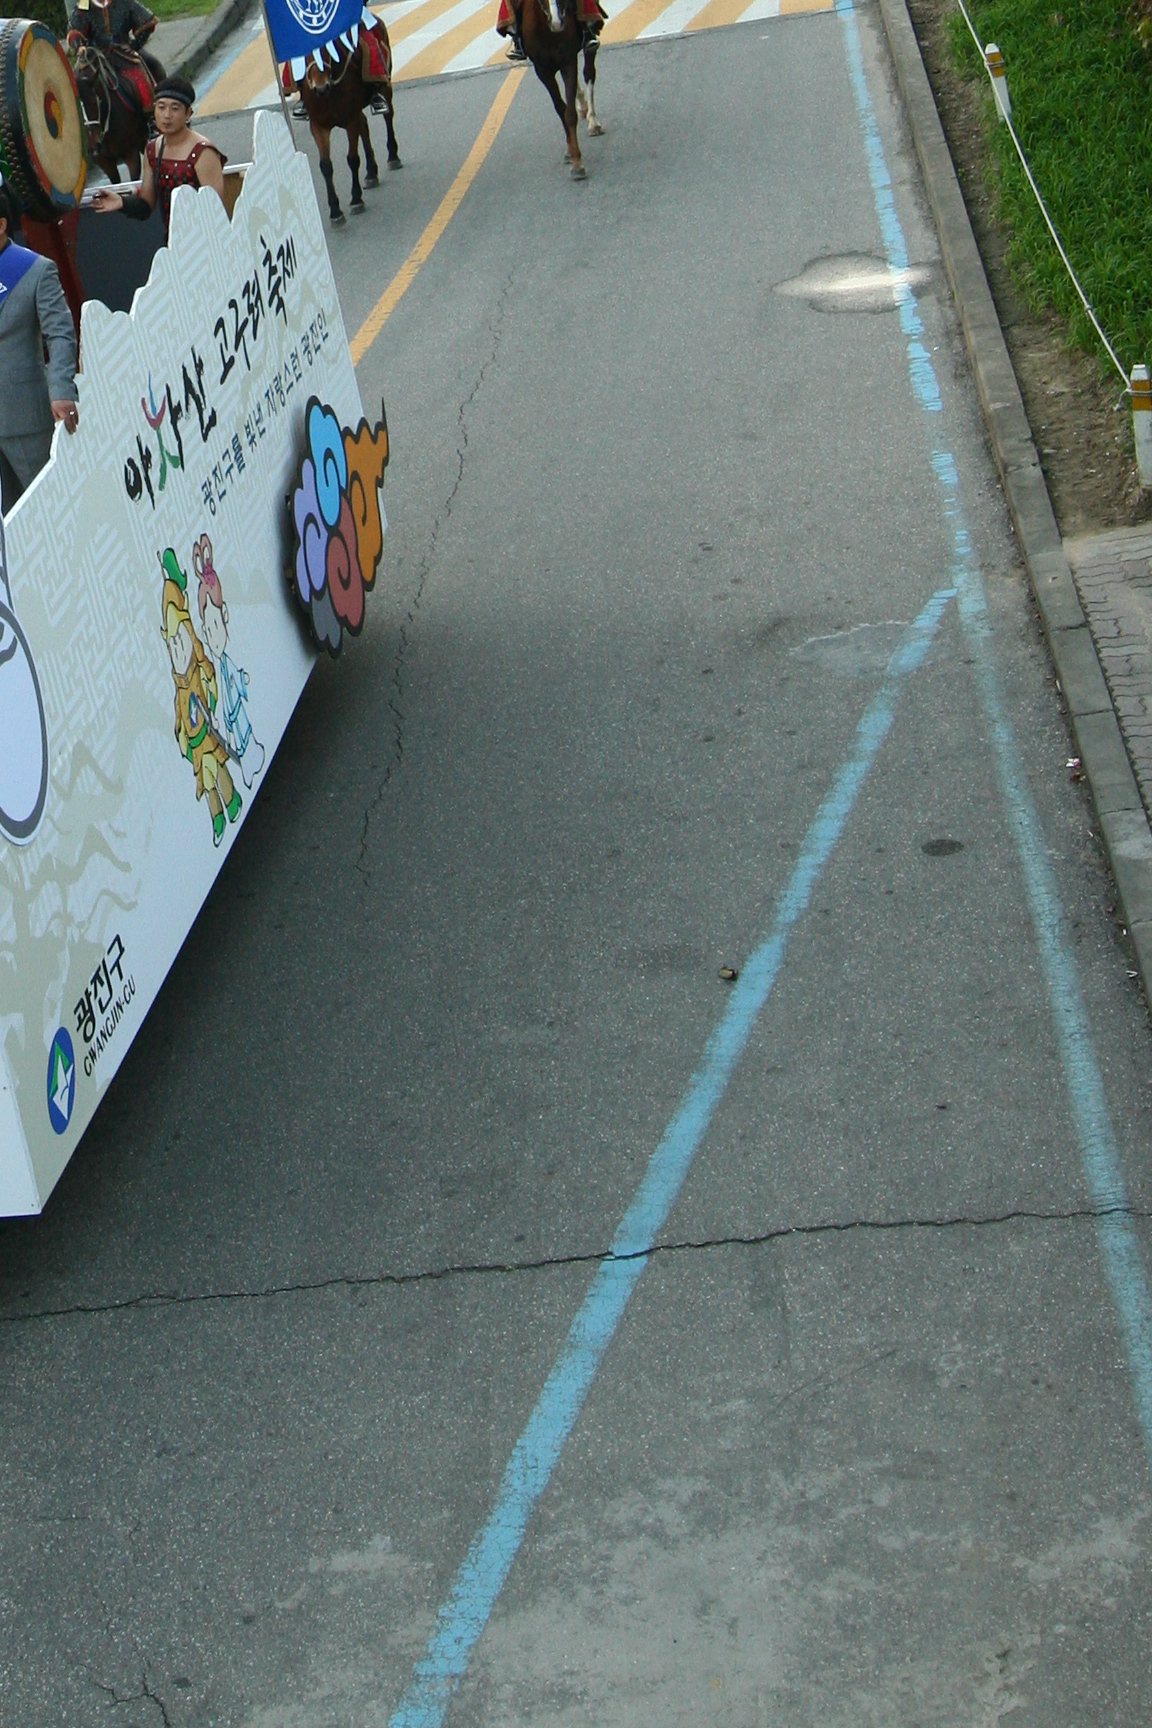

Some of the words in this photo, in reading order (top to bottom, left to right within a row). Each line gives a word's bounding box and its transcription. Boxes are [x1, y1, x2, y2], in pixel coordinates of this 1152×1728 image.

[124, 345, 217, 511] 아차산
[214, 268, 265, 385] 고구려
[260, 234, 298, 327] 축제
[201, 433, 246, 516] 광진구를
[244, 401, 267, 453] 빛낸
[264, 345, 303, 419] 자랑스런
[300, 307, 329, 367] 광진인
[73, 933, 126, 1044] 광진구
[83, 974, 137, 1078] GWANGJIN-GU
